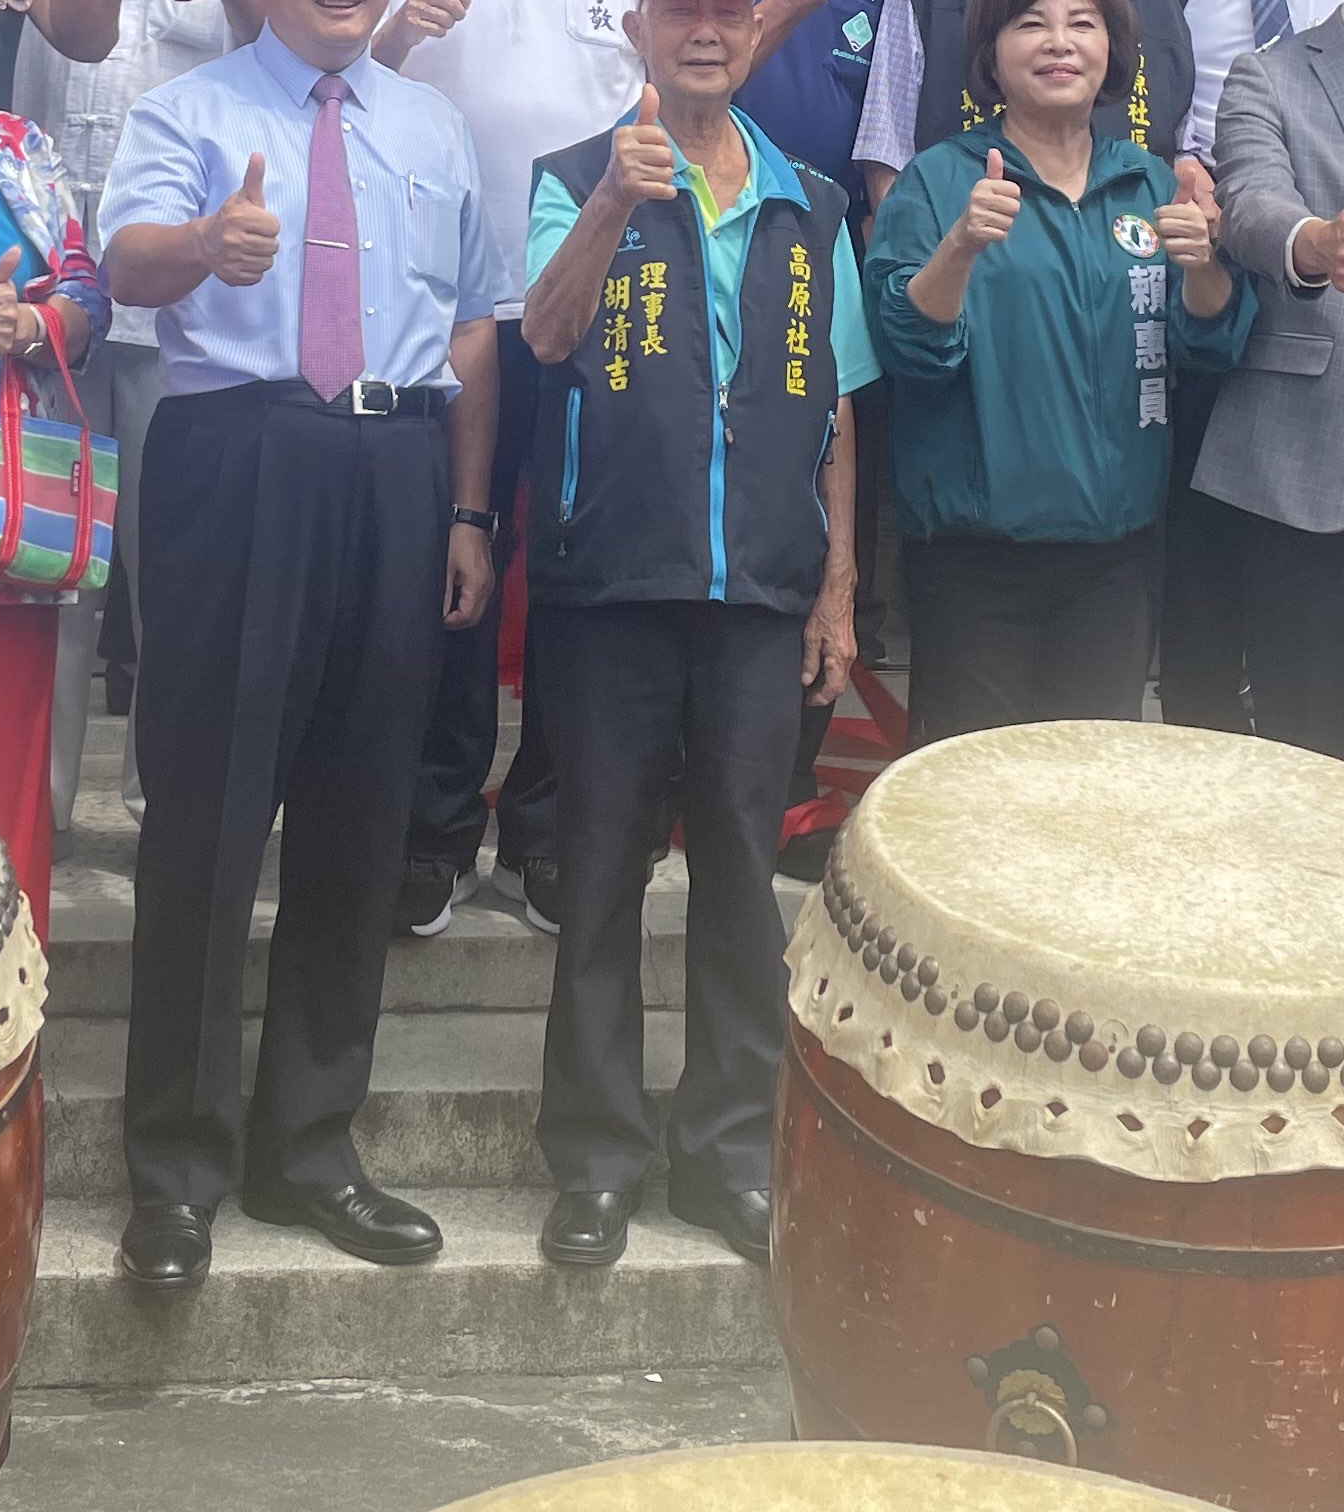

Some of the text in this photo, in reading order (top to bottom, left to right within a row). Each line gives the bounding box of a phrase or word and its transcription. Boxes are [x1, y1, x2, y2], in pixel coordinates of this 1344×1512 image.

[1127, 44, 1151, 151] 原社區
[603, 275, 634, 393] 胡清吉
[639, 261, 668, 357] 理事長
[786, 243, 813, 397] 高原社區
[1128, 264, 1169, 430] 賴惠員
